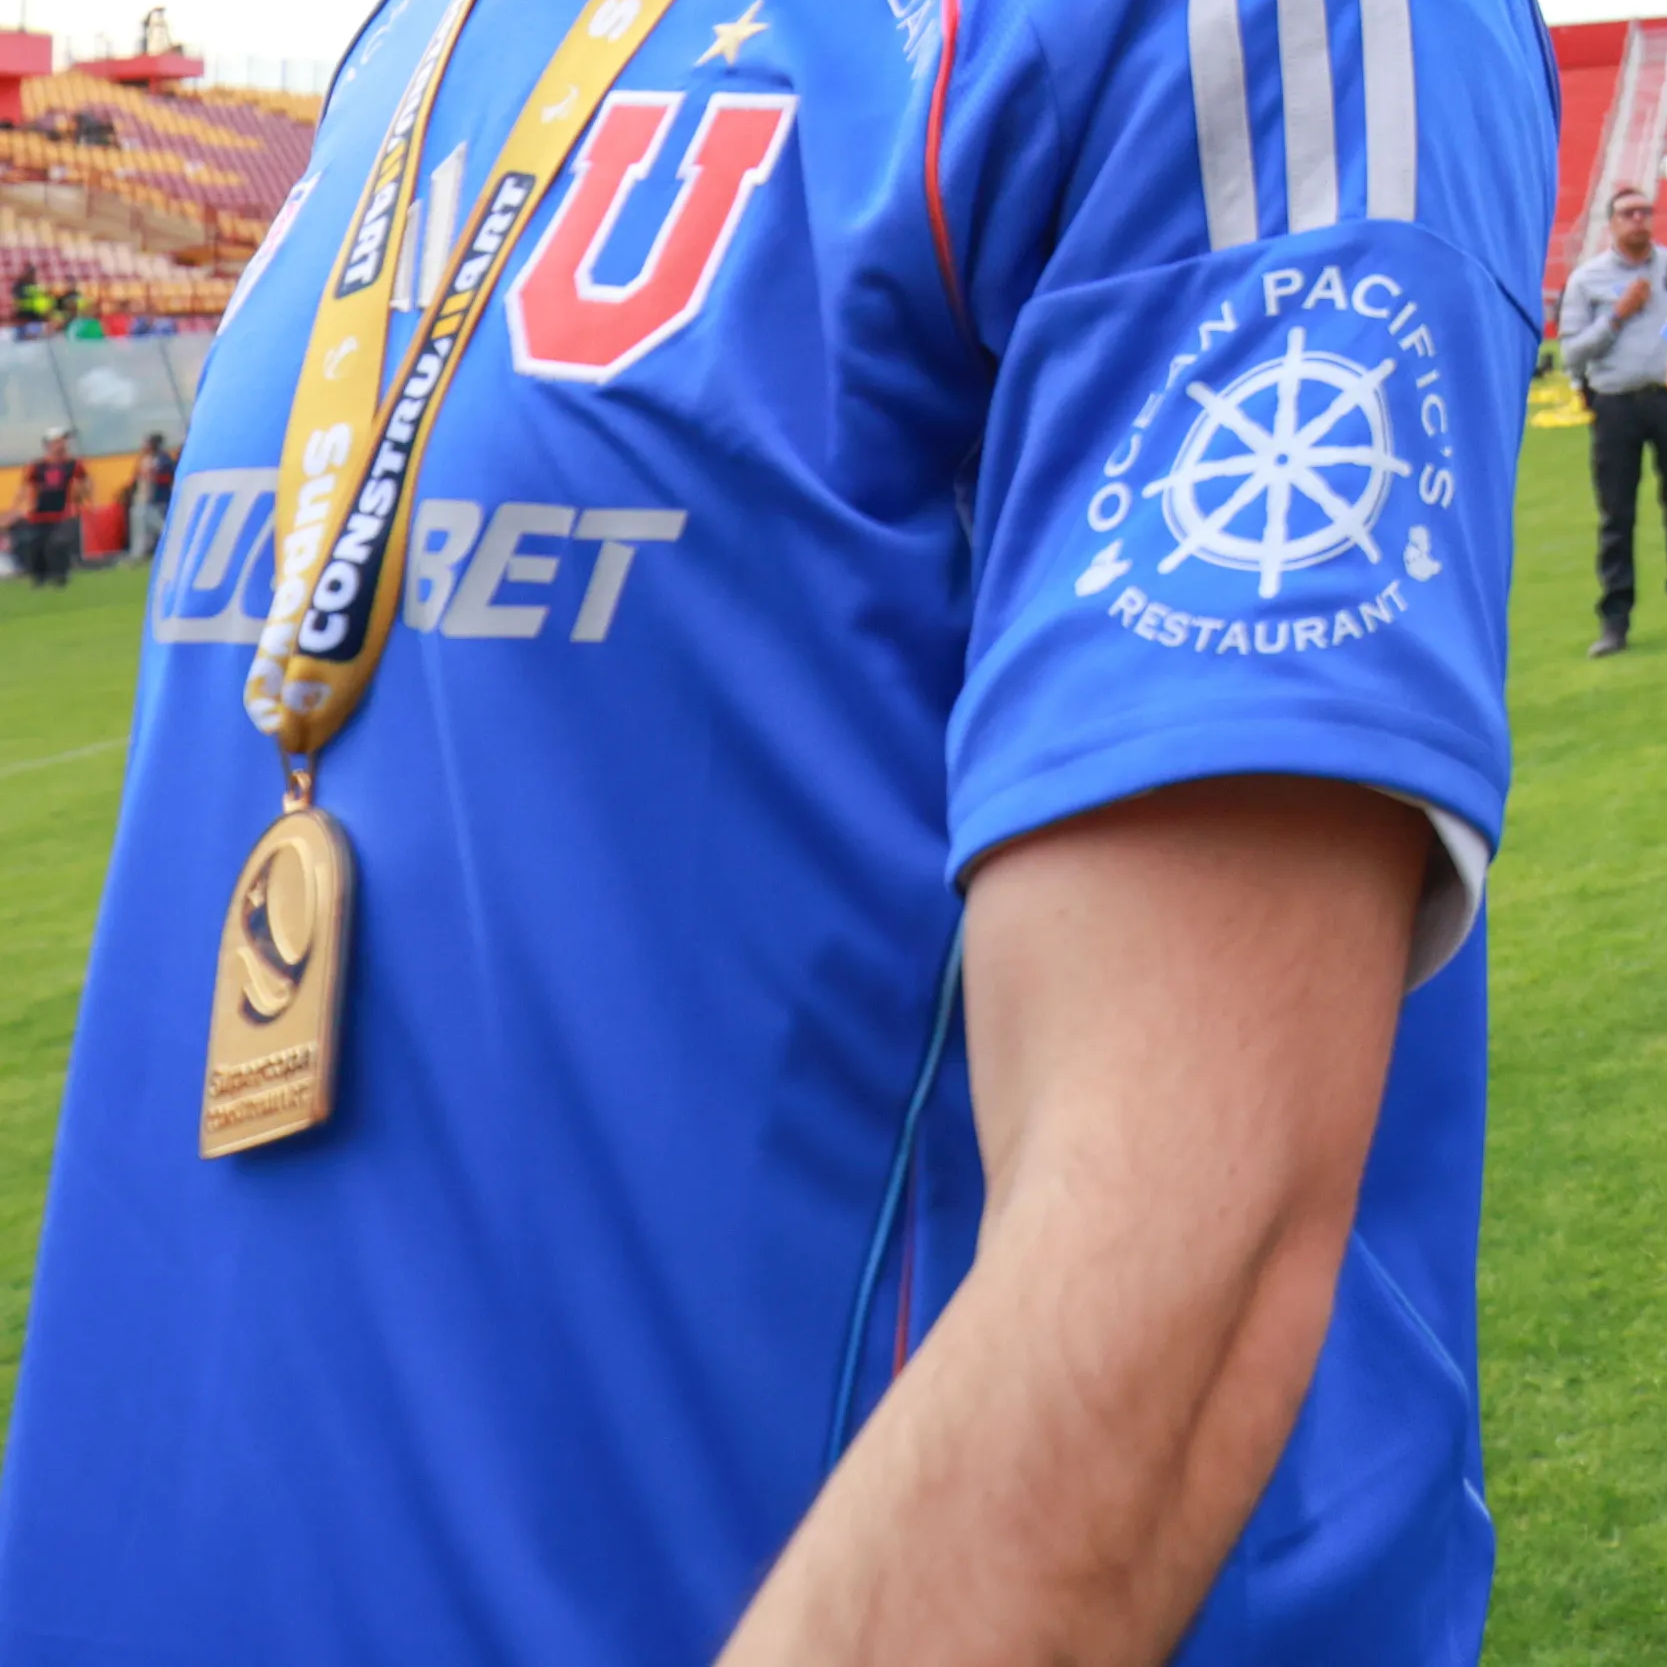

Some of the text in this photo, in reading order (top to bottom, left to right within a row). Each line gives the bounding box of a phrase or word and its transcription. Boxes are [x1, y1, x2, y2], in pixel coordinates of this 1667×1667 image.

[506, 90, 799, 383] U
[1261, 265, 1456, 510] PACIFIC'S
[1106, 579, 1411, 656] RESTAURANT
